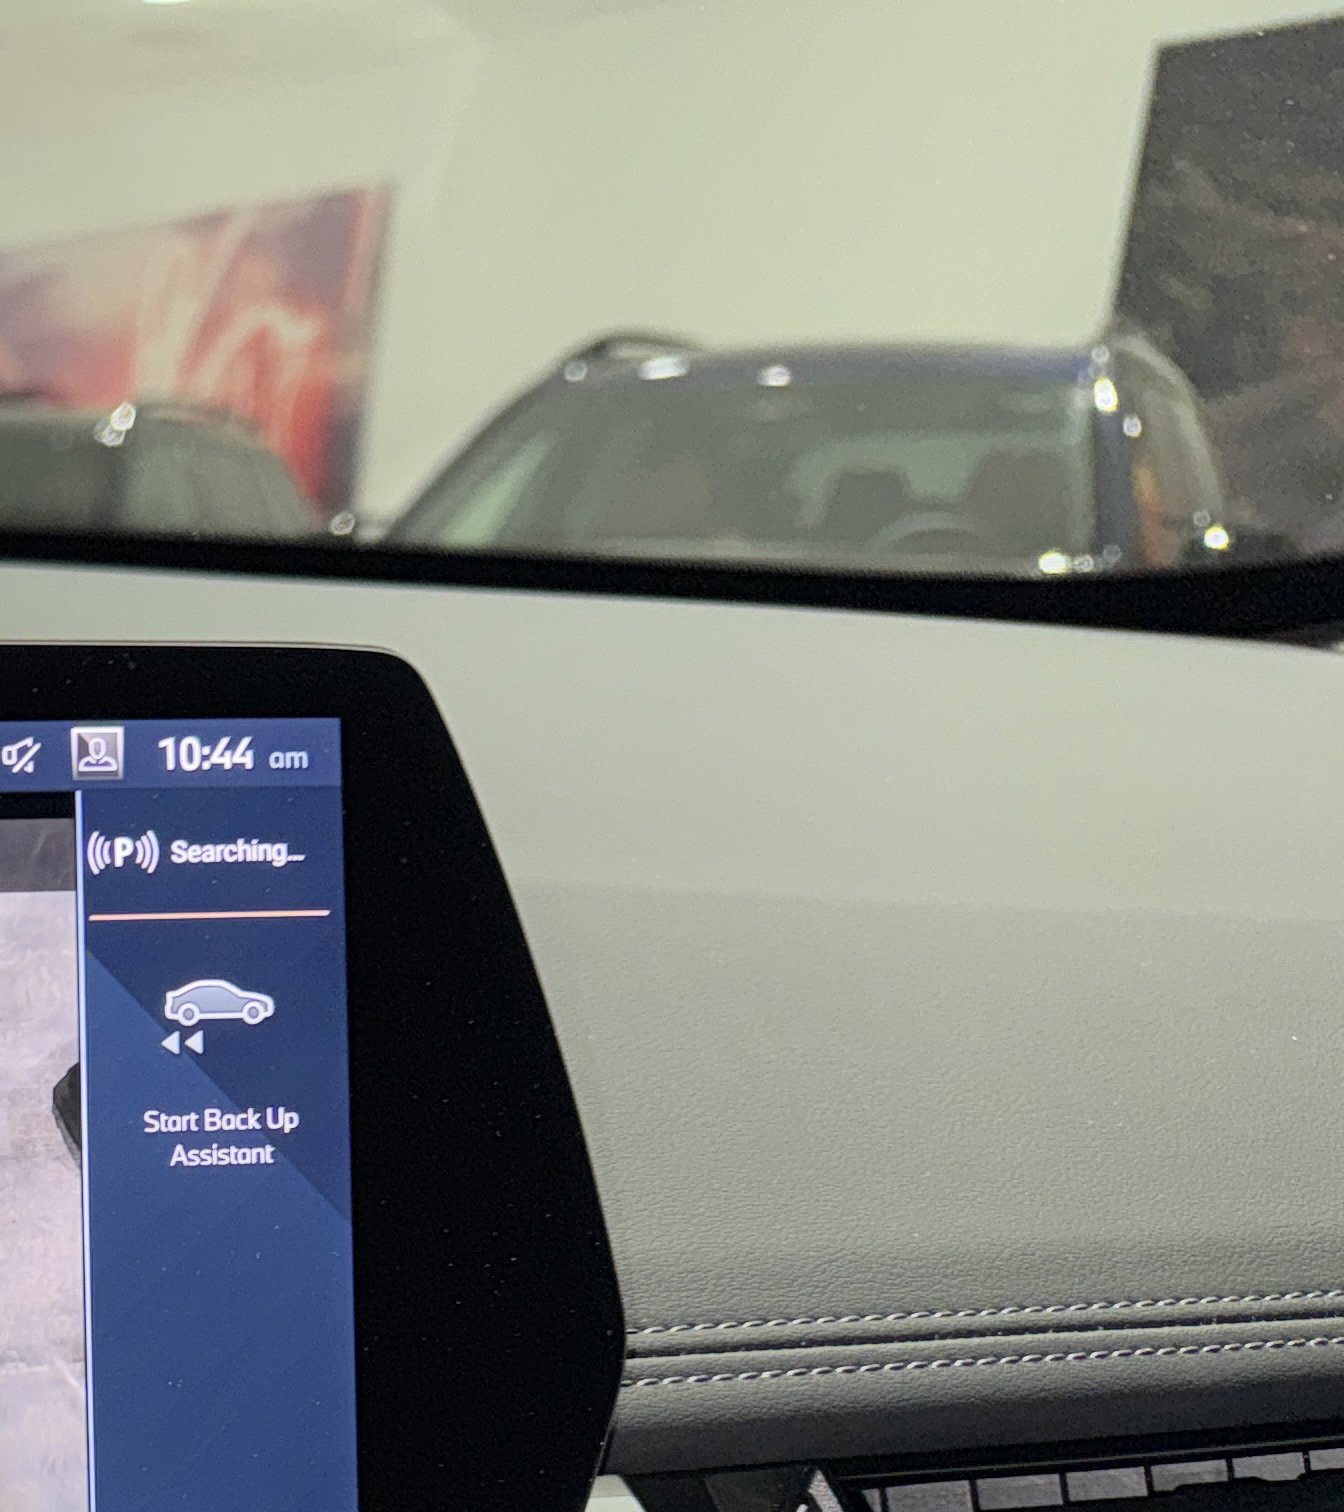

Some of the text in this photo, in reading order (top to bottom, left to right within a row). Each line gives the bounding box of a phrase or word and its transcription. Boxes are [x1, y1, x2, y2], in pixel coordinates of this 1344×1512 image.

[157, 735, 310, 773] 10:44 am
[143, 1106, 300, 1136] Start Back Up
[169, 1141, 275, 1168] Assistant
